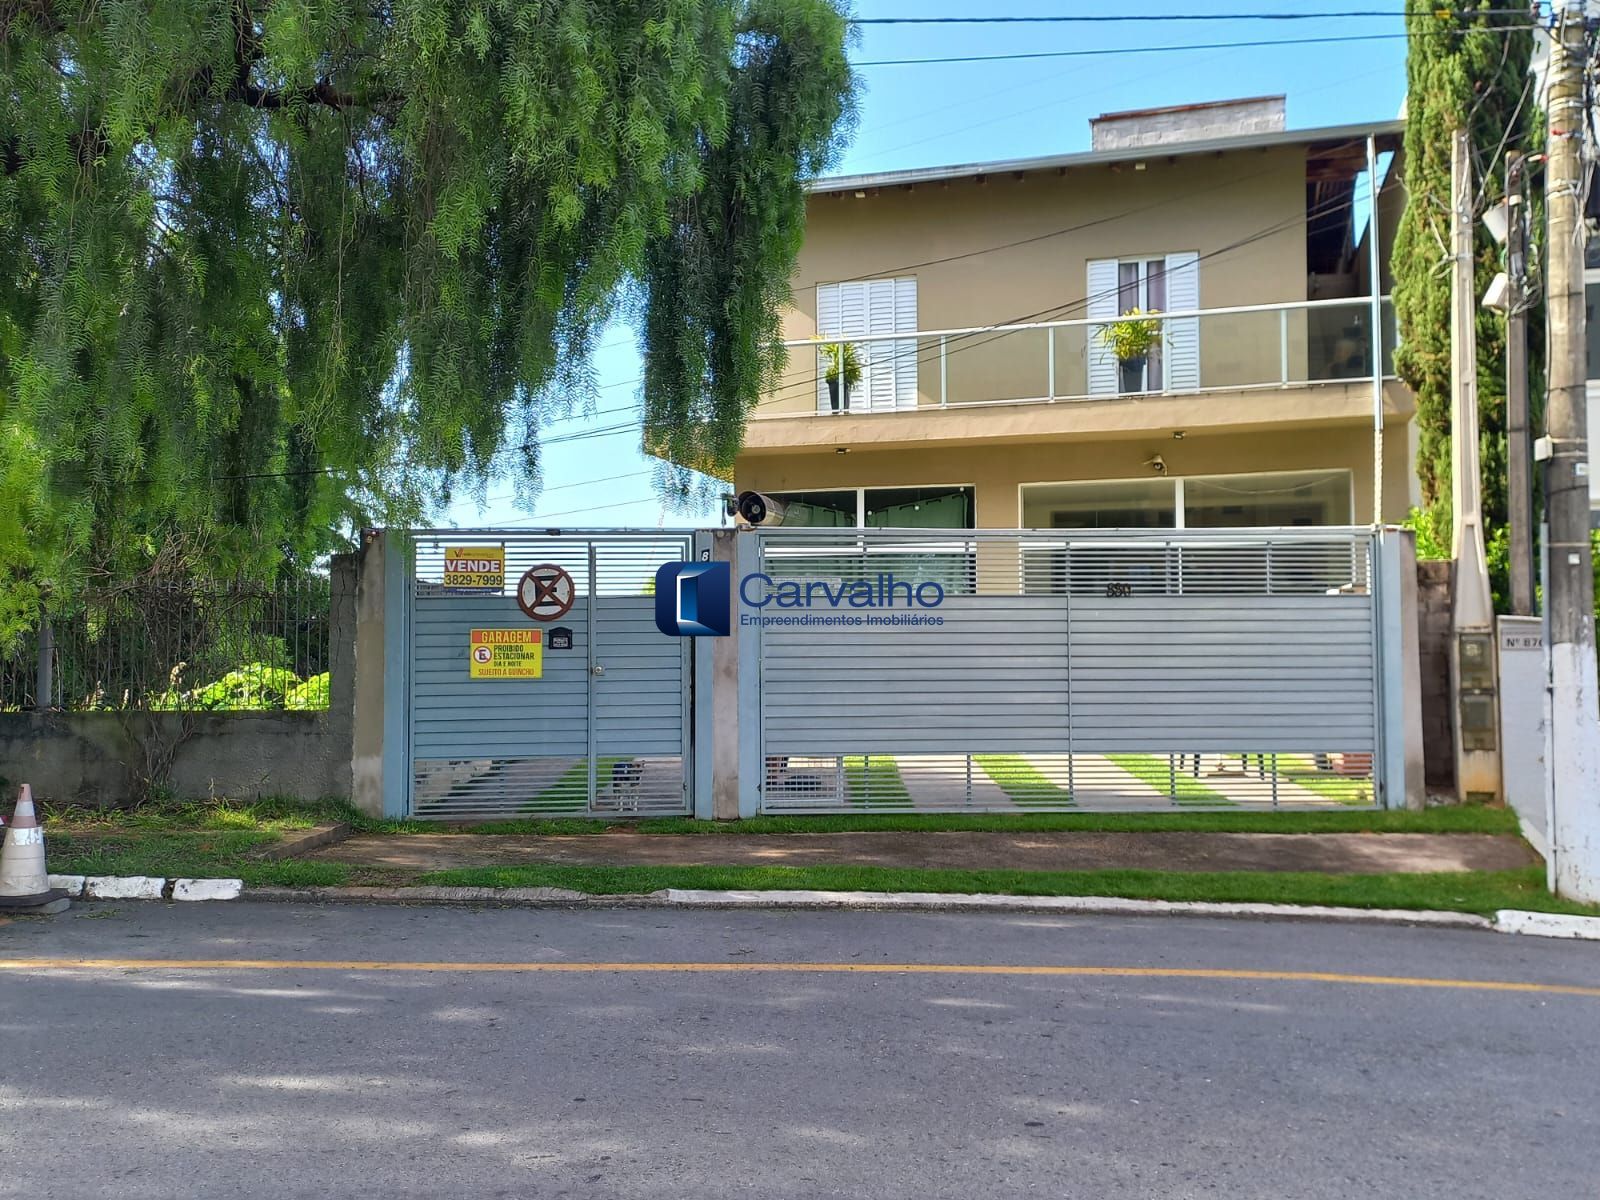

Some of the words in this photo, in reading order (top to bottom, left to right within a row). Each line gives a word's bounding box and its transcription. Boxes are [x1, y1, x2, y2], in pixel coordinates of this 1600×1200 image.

[446, 559, 500, 572] VENDE
[445, 574, 503, 586] 3829-7999
[481, 631, 532, 643] GARAGEM
[493, 644, 524, 652] PROIBIDO
[493, 652, 535, 660] ESTACIONAR
[478, 668, 502, 676] SUJEITO
